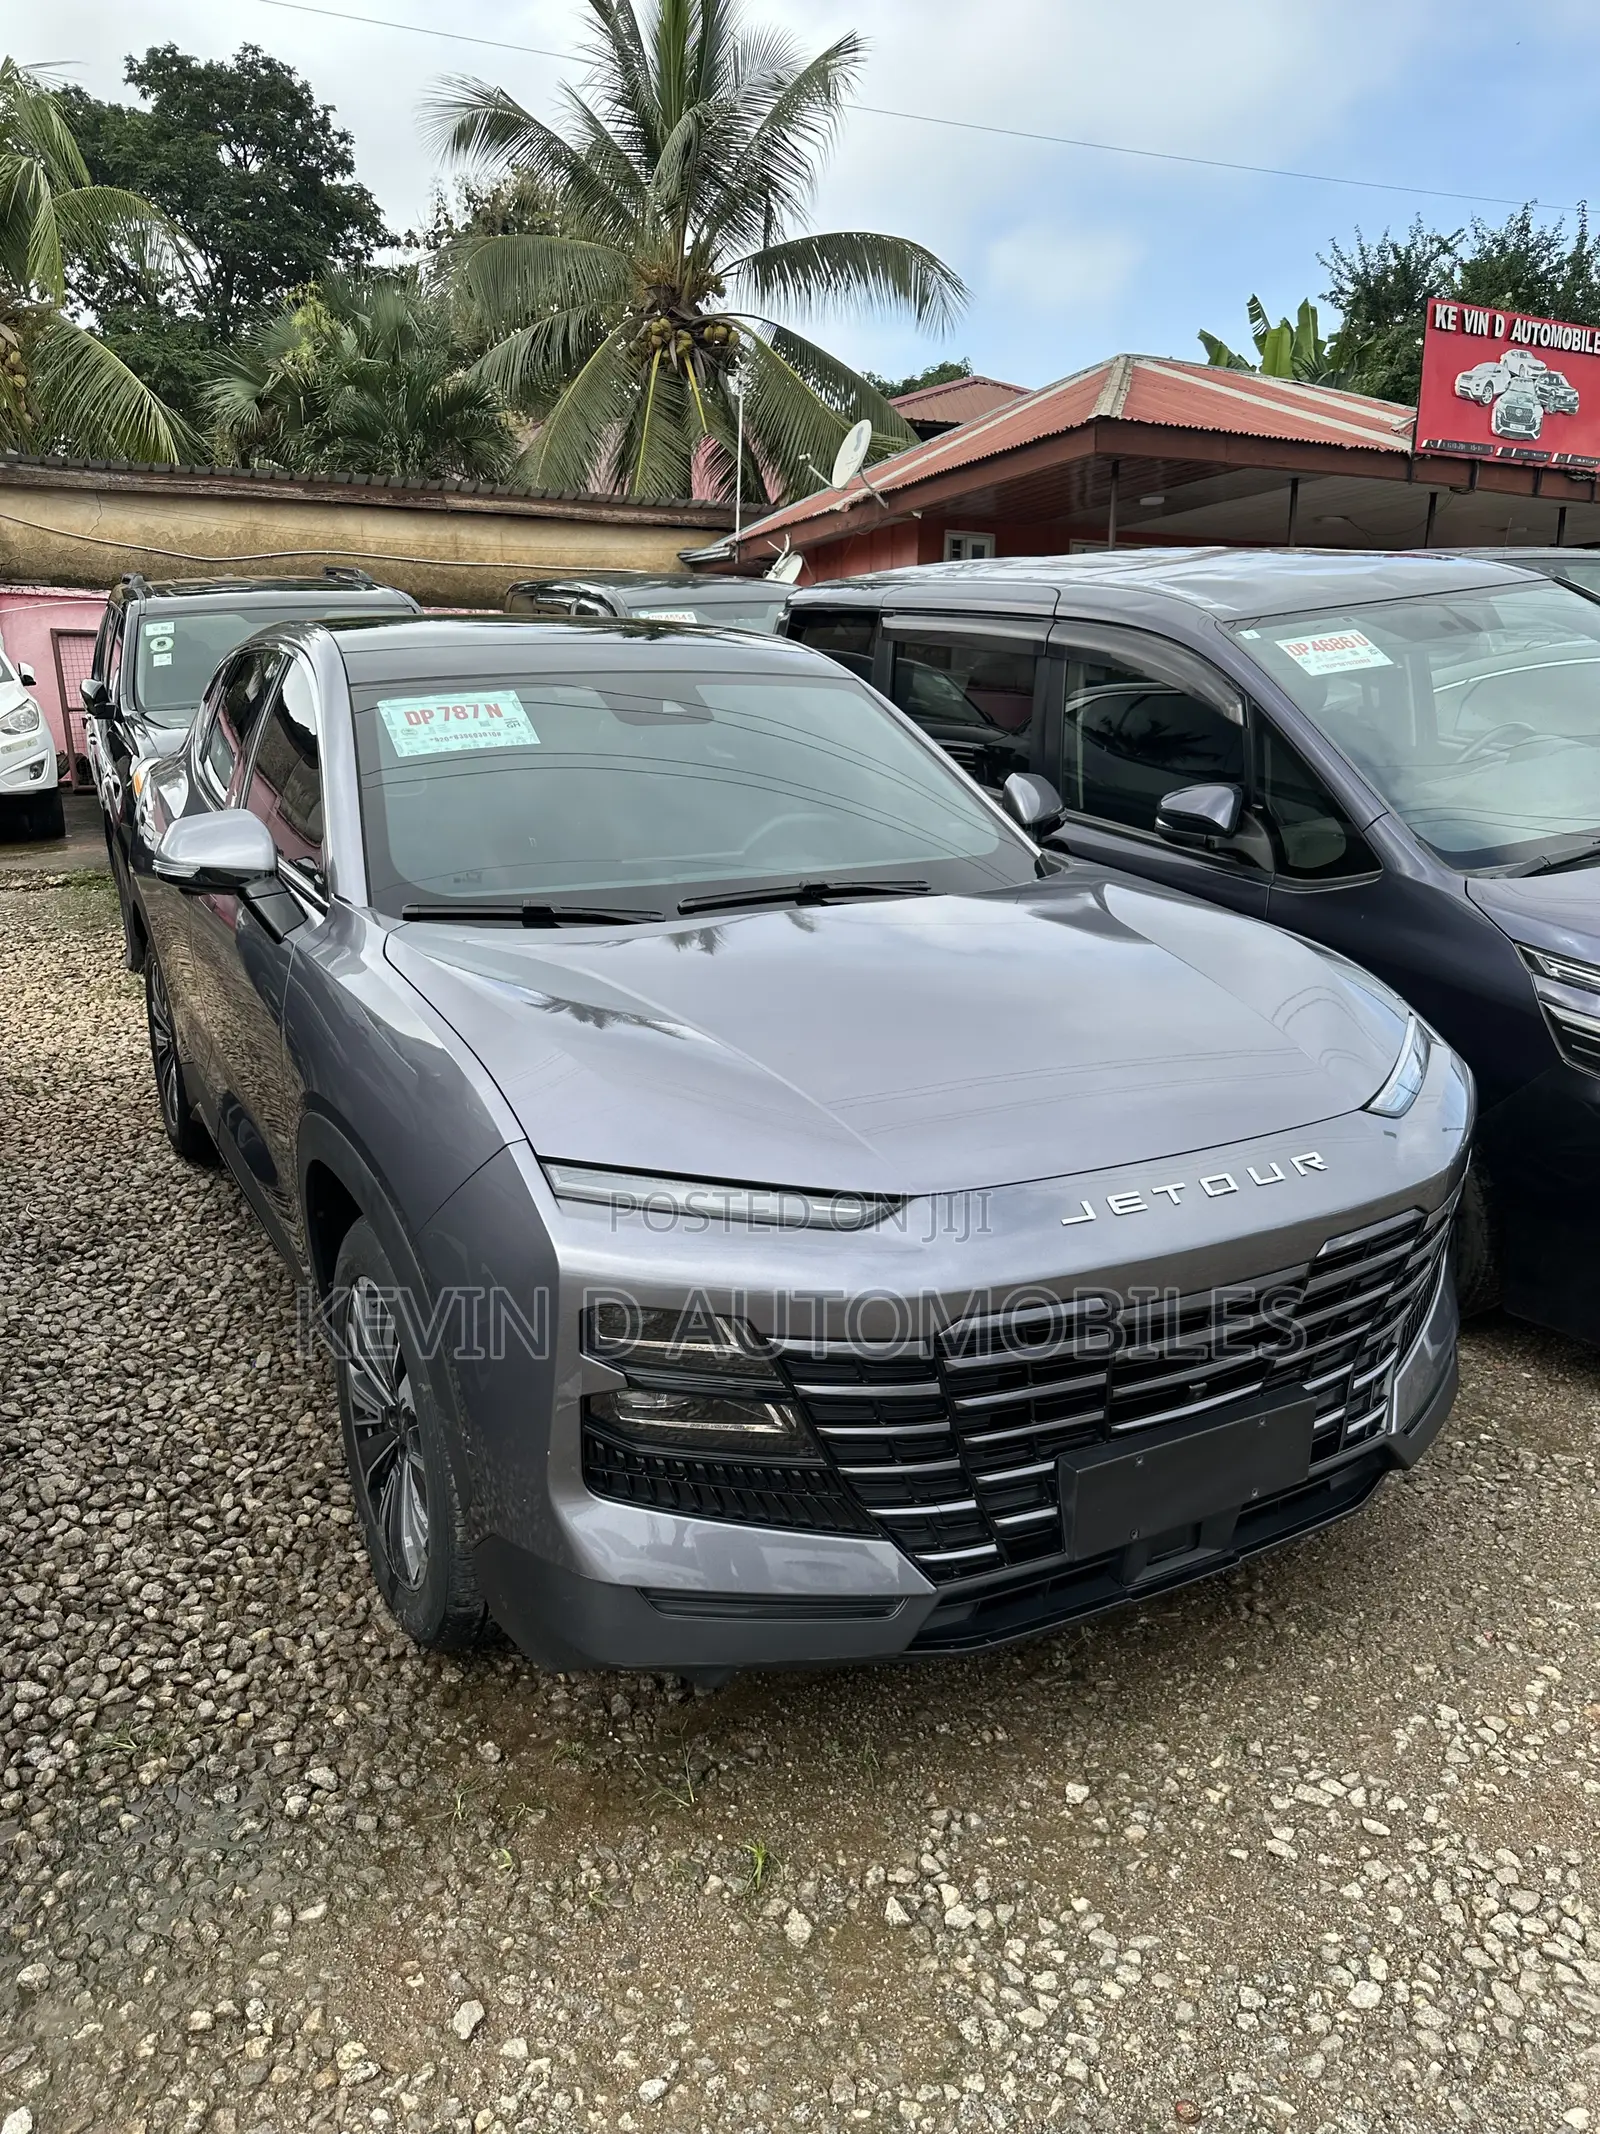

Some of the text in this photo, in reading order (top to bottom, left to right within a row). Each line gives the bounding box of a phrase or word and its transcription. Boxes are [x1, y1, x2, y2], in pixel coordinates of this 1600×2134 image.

[1494, 314, 1505, 338] D
[1284, 643, 1309, 657] DP
[1311, 636, 1356, 653] 4686
[1350, 634, 1369, 647] U
[404, 703, 503, 726] DP 787 N
[1061, 1151, 1329, 1226] JETOUR
